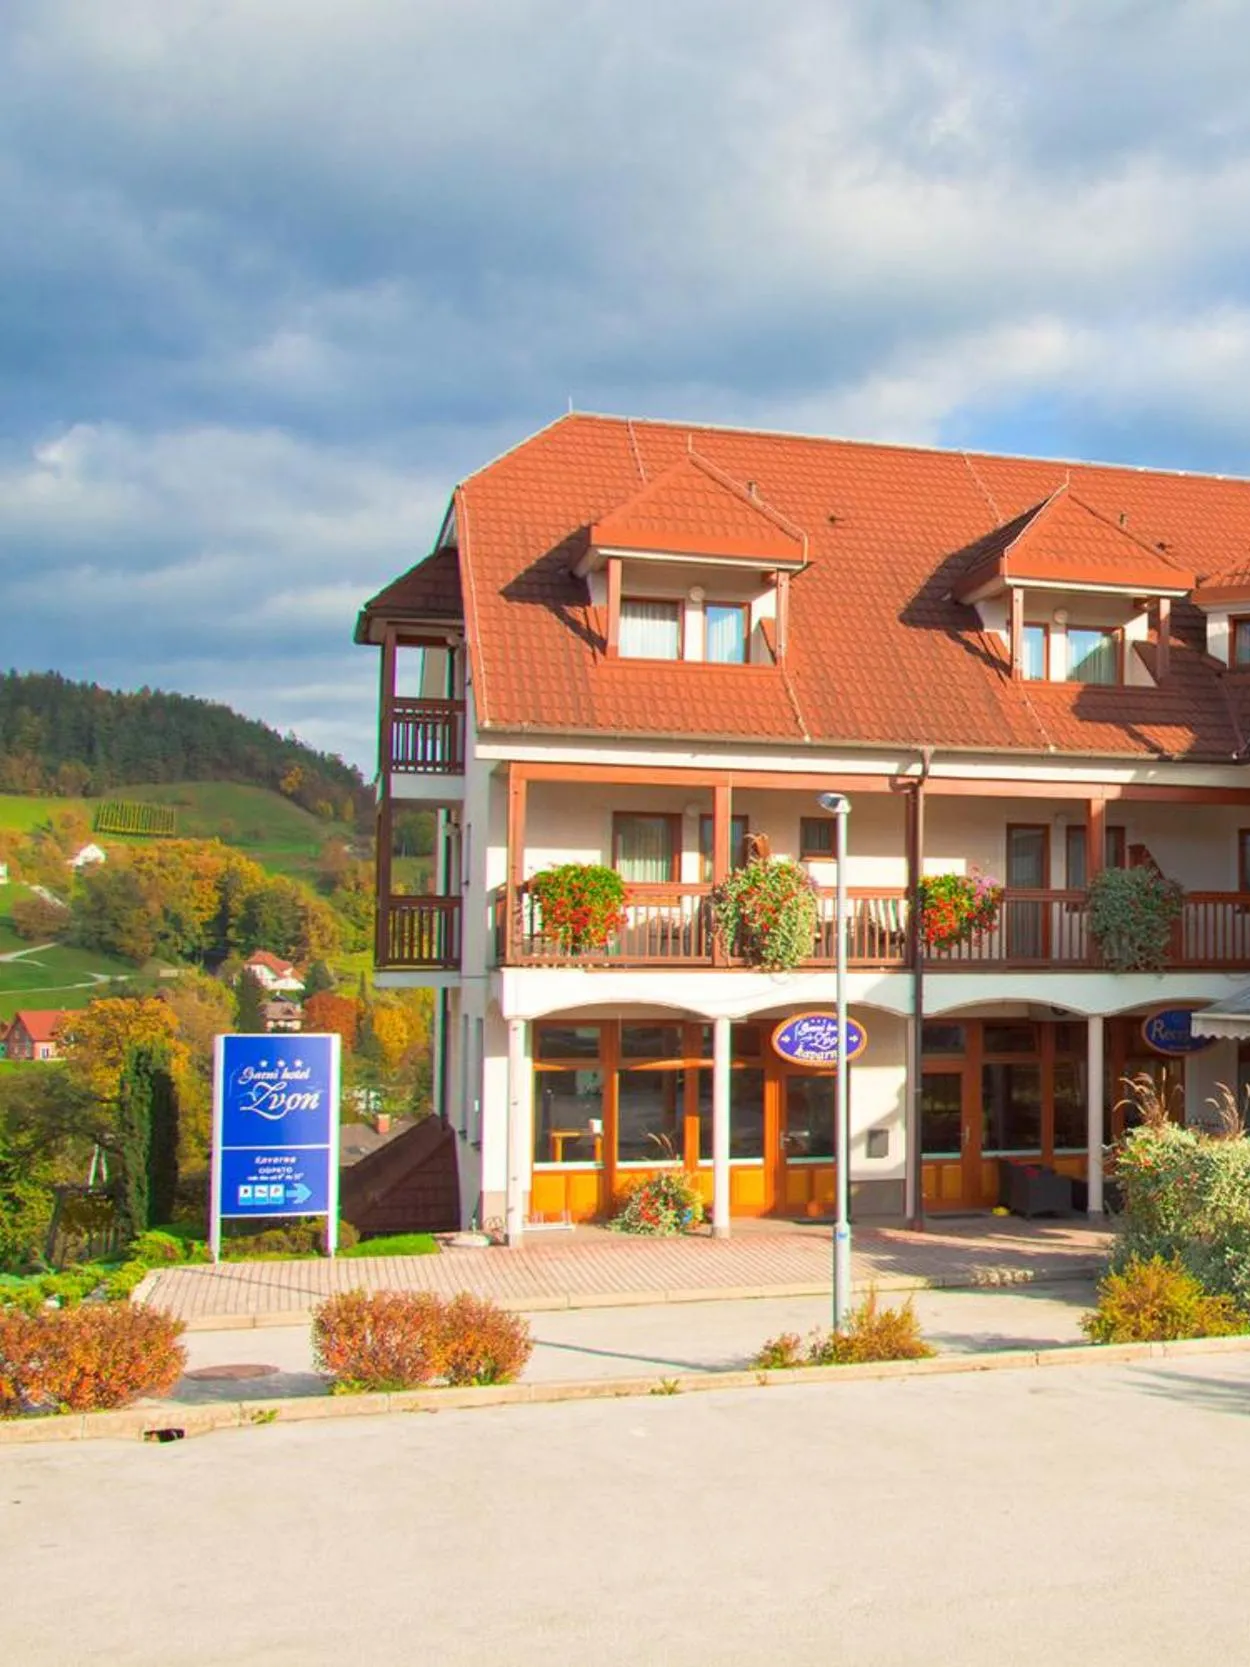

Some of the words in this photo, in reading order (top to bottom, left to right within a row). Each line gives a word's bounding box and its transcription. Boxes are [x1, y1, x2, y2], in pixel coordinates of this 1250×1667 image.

[809, 1032, 837, 1050] Zvo
[238, 1066, 279, 1085] Garni
[280, 1068, 310, 1081] hotel
[239, 1081, 320, 1120] Zvon
